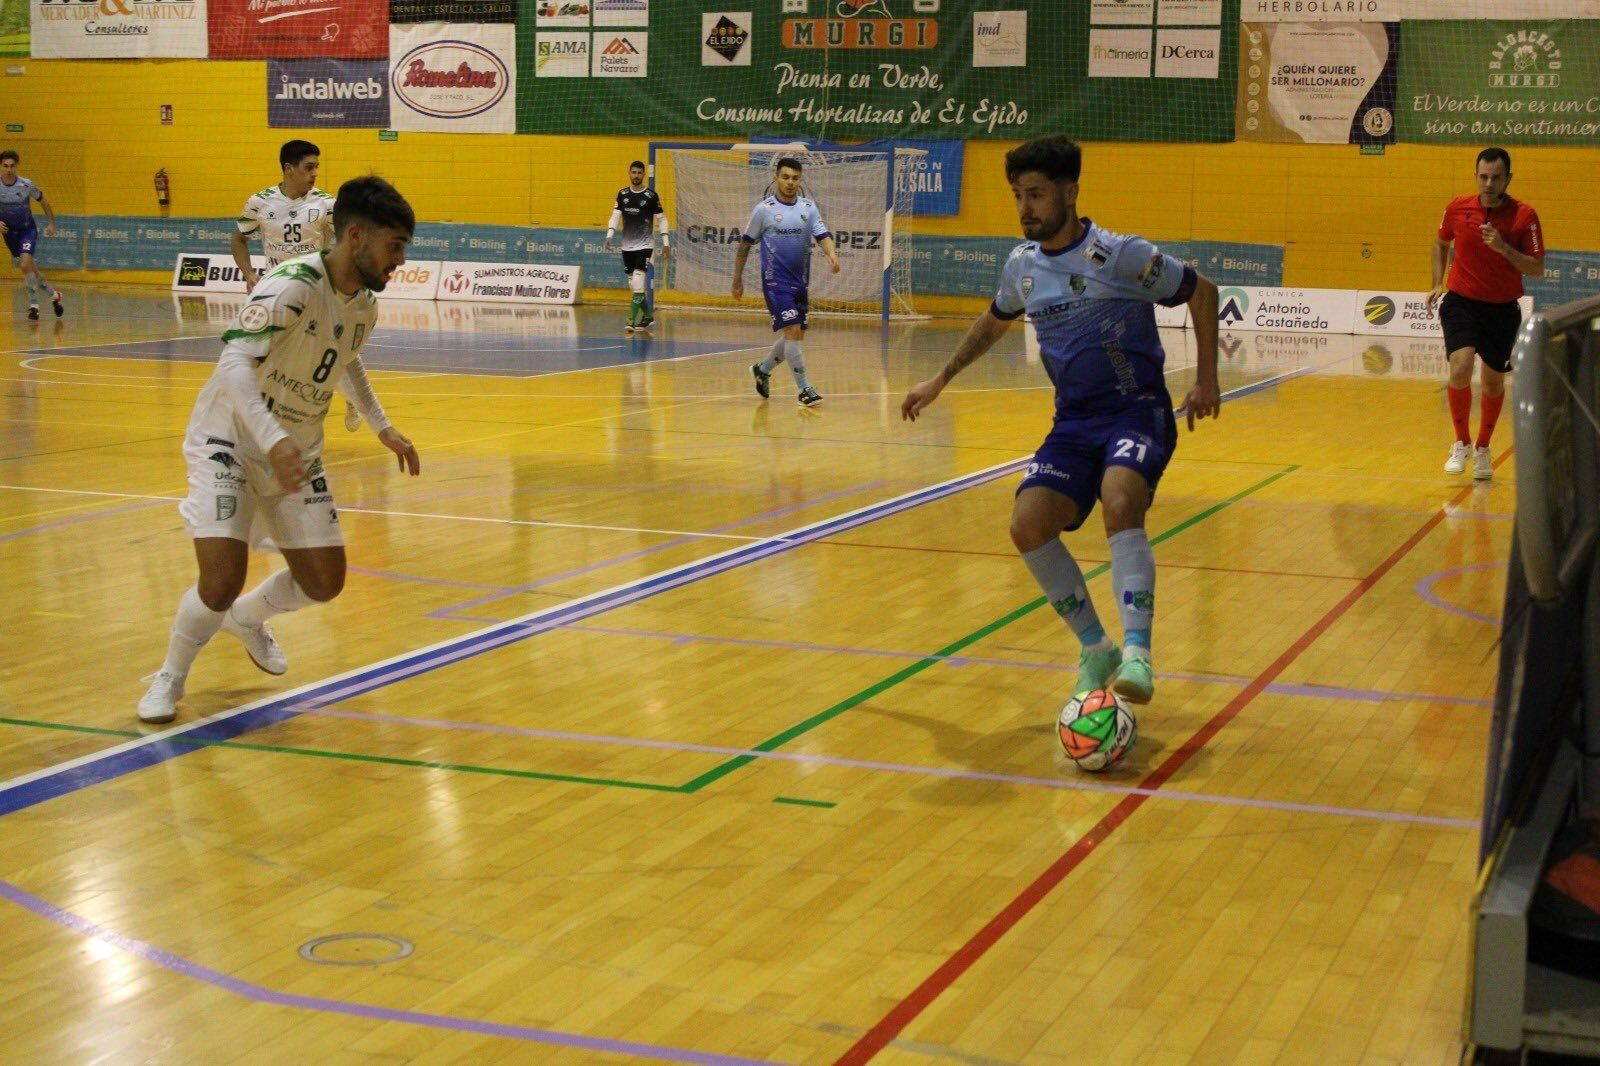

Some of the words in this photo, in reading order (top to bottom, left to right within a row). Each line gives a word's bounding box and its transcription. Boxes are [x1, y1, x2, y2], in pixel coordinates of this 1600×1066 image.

[40, 5, 99, 20] MERCADER
[1257, 1, 1378, 12] HERBOLARIO
[84, 21, 149, 34] Consultores
[793, 21, 930, 47] MURGI
[538, 41, 587, 56] SAMA
[600, 56, 629, 65] Palets
[600, 65, 640, 73] Navarro
[1318, 64, 1357, 76] QUIERE
[774, 62, 843, 95] Piensa
[848, 73, 871, 89] en
[878, 63, 944, 92] Verde,
[1271, 77, 1290, 86] SER
[1292, 77, 1366, 88] MILLONARIO?
[275, 74, 383, 100] indalweb
[1413, 94, 1434, 112] El
[1436, 94, 1494, 112] Verde
[1497, 101, 1525, 112] no
[1528, 101, 1550, 114] es
[1552, 103, 1584, 113] un
[696, 97, 783, 123] Consume
[788, 98, 904, 124] Hortalizas
[910, 101, 931, 124] de
[938, 98, 966, 125] El
[972, 98, 1029, 134] Ejido
[1424, 119, 1468, 135] sino
[909, 172, 943, 193] SALA
[95, 229, 129, 239] Bioline
[146, 229, 181, 240] Bioline
[198, 229, 232, 240] Bioline
[283, 223, 302, 243] 25
[413, 236, 450, 249] Bioline
[469, 238, 507, 251] Bioline
[526, 241, 565, 254] Bioline
[954, 250, 997, 263] Bioline
[1222, 258, 1268, 272] Bioline
[474, 268, 525, 279] SUMINISTROS
[472, 283, 513, 297] Francisco
[514, 284, 542, 297] Muñoz
[544, 285, 571, 299] Flores
[1257, 301, 1311, 315] Antonio
[781, 309, 799, 321] 30
[1402, 312, 1434, 321] PACO
[1255, 315, 1328, 329] Castañeda
[1411, 323, 1427, 331] 625
[312, 348, 338, 384] 8
[1113, 438, 1148, 463] 21
